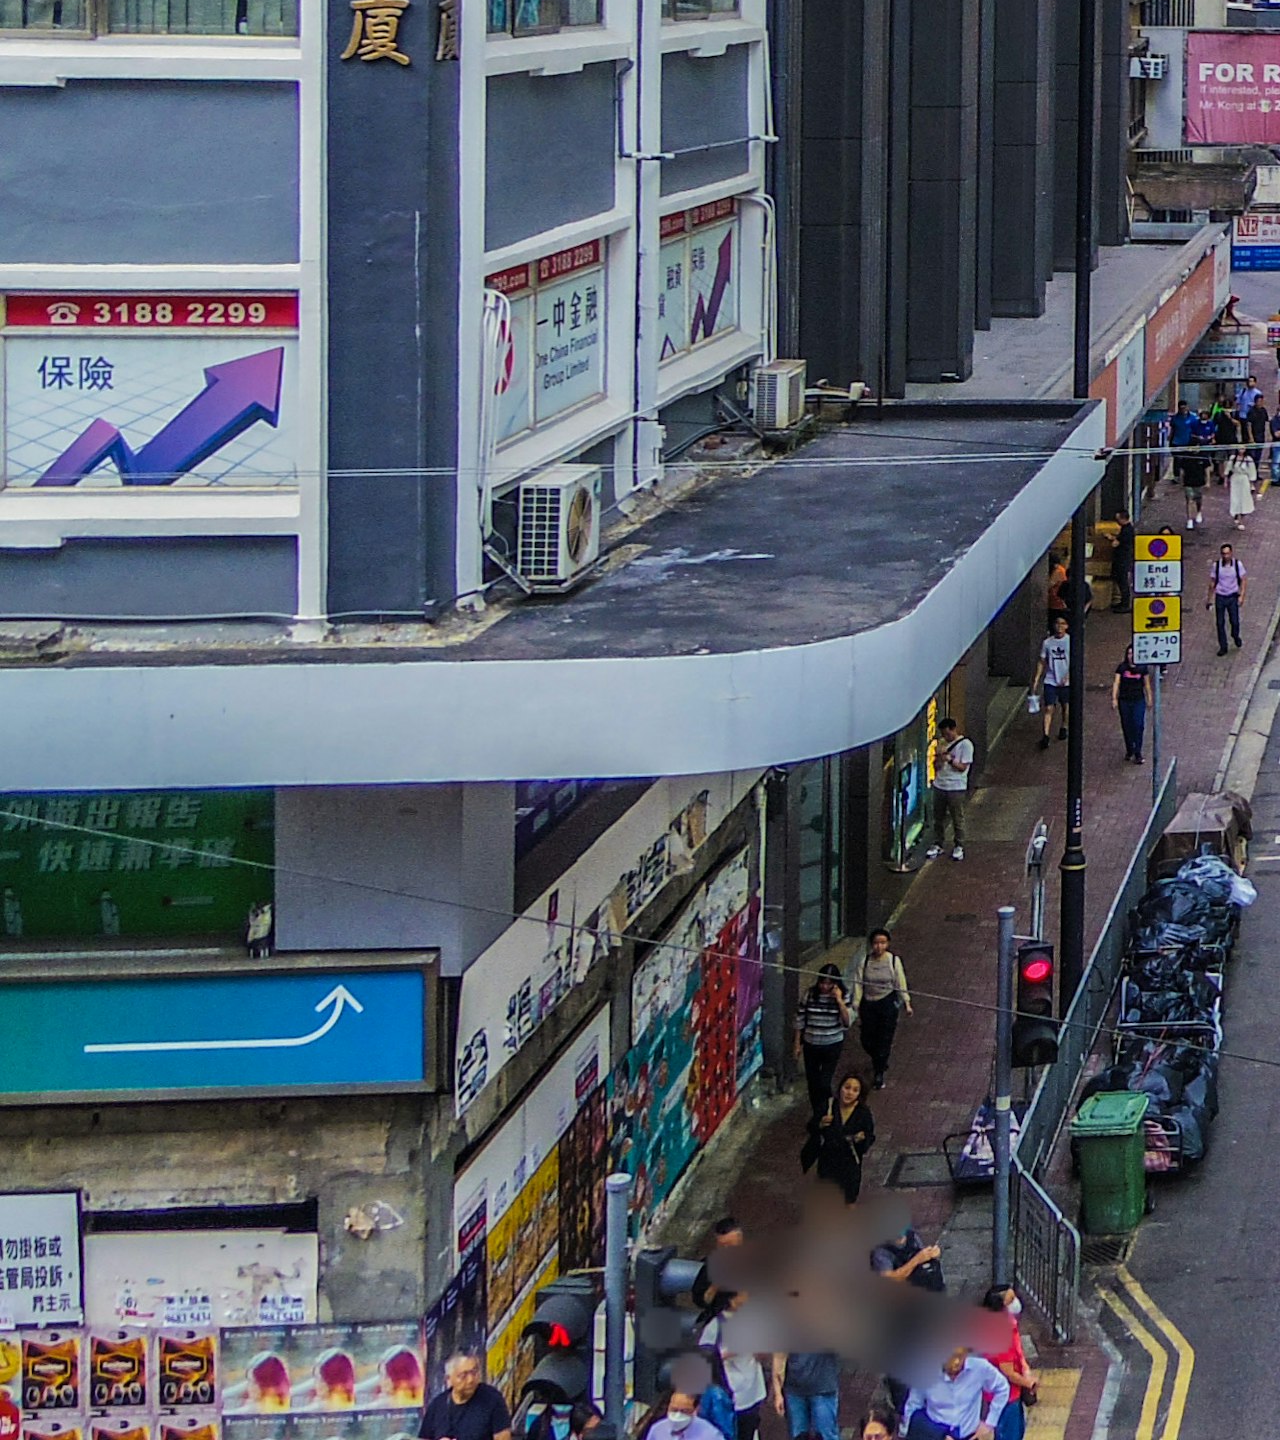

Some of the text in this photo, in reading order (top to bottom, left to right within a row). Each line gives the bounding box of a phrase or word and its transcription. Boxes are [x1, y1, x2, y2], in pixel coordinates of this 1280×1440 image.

[1199, 63, 1254, 83] FOR
[1209, 86, 1262, 96] interested,
[1217, 101, 1244, 112] Kong
[1246, 102, 1257, 110] at
[1237, 216, 1259, 237] NE
[93, 302, 267, 323] 3188 2299
[536, 286, 598, 338] 一中金融
[550, 339, 569, 361] China
[37, 355, 115, 392] 保險
[543, 355, 590, 391] Group Limited
[1147, 564, 1169, 574] End
[1143, 576, 1173, 589] 終止
[1152, 635, 1178, 645] 7-10
[1151, 649, 1171, 659] 4-7
